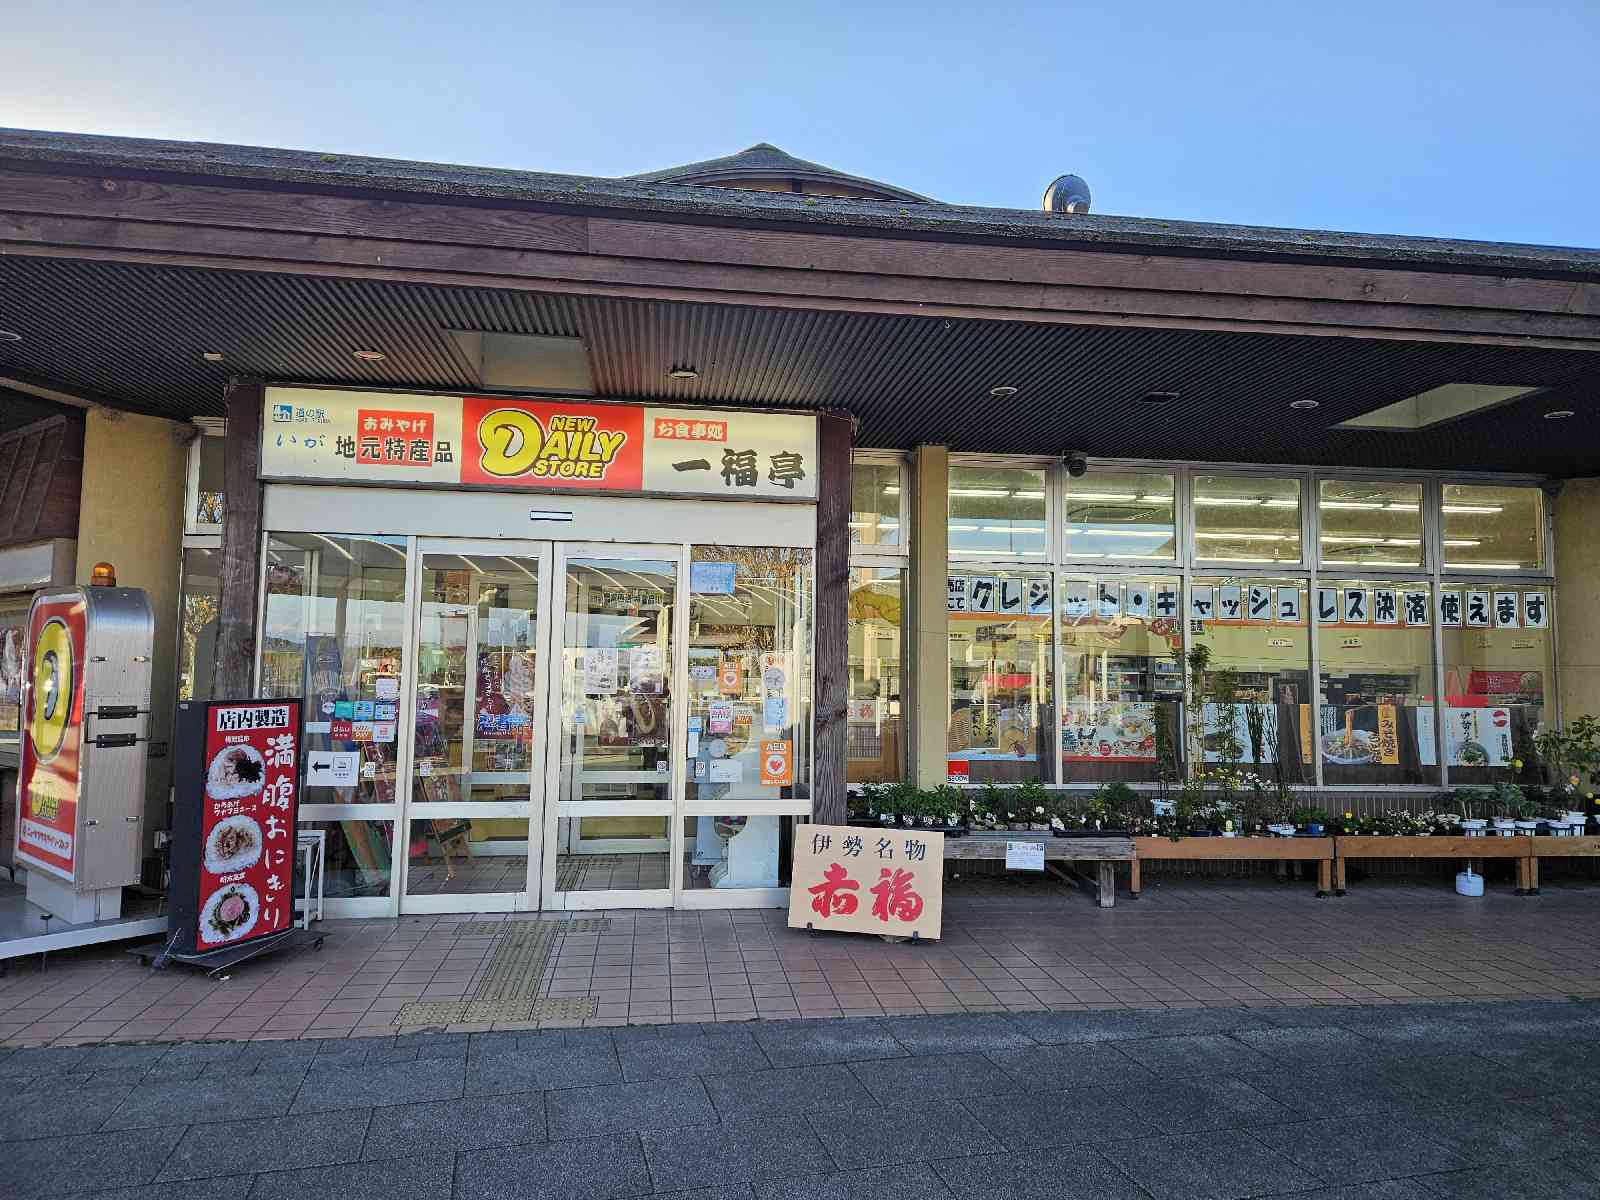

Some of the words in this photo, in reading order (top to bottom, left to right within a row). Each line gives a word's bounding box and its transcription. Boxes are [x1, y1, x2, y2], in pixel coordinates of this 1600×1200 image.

[363, 416, 428, 433] おみやげ
[551, 416, 595, 432] NEW
[657, 422, 723, 440] お食事処
[275, 433, 326, 448] いが
[335, 435, 453, 463] 地元特産品
[532, 460, 604, 478] STORE
[672, 448, 806, 490] 一福亭
[219, 708, 287, 730] 店内製造
[261, 732, 297, 929] 満腹おにぎり
[811, 832, 927, 862] 伊勢名物
[808, 862, 924, 922] 赤福
